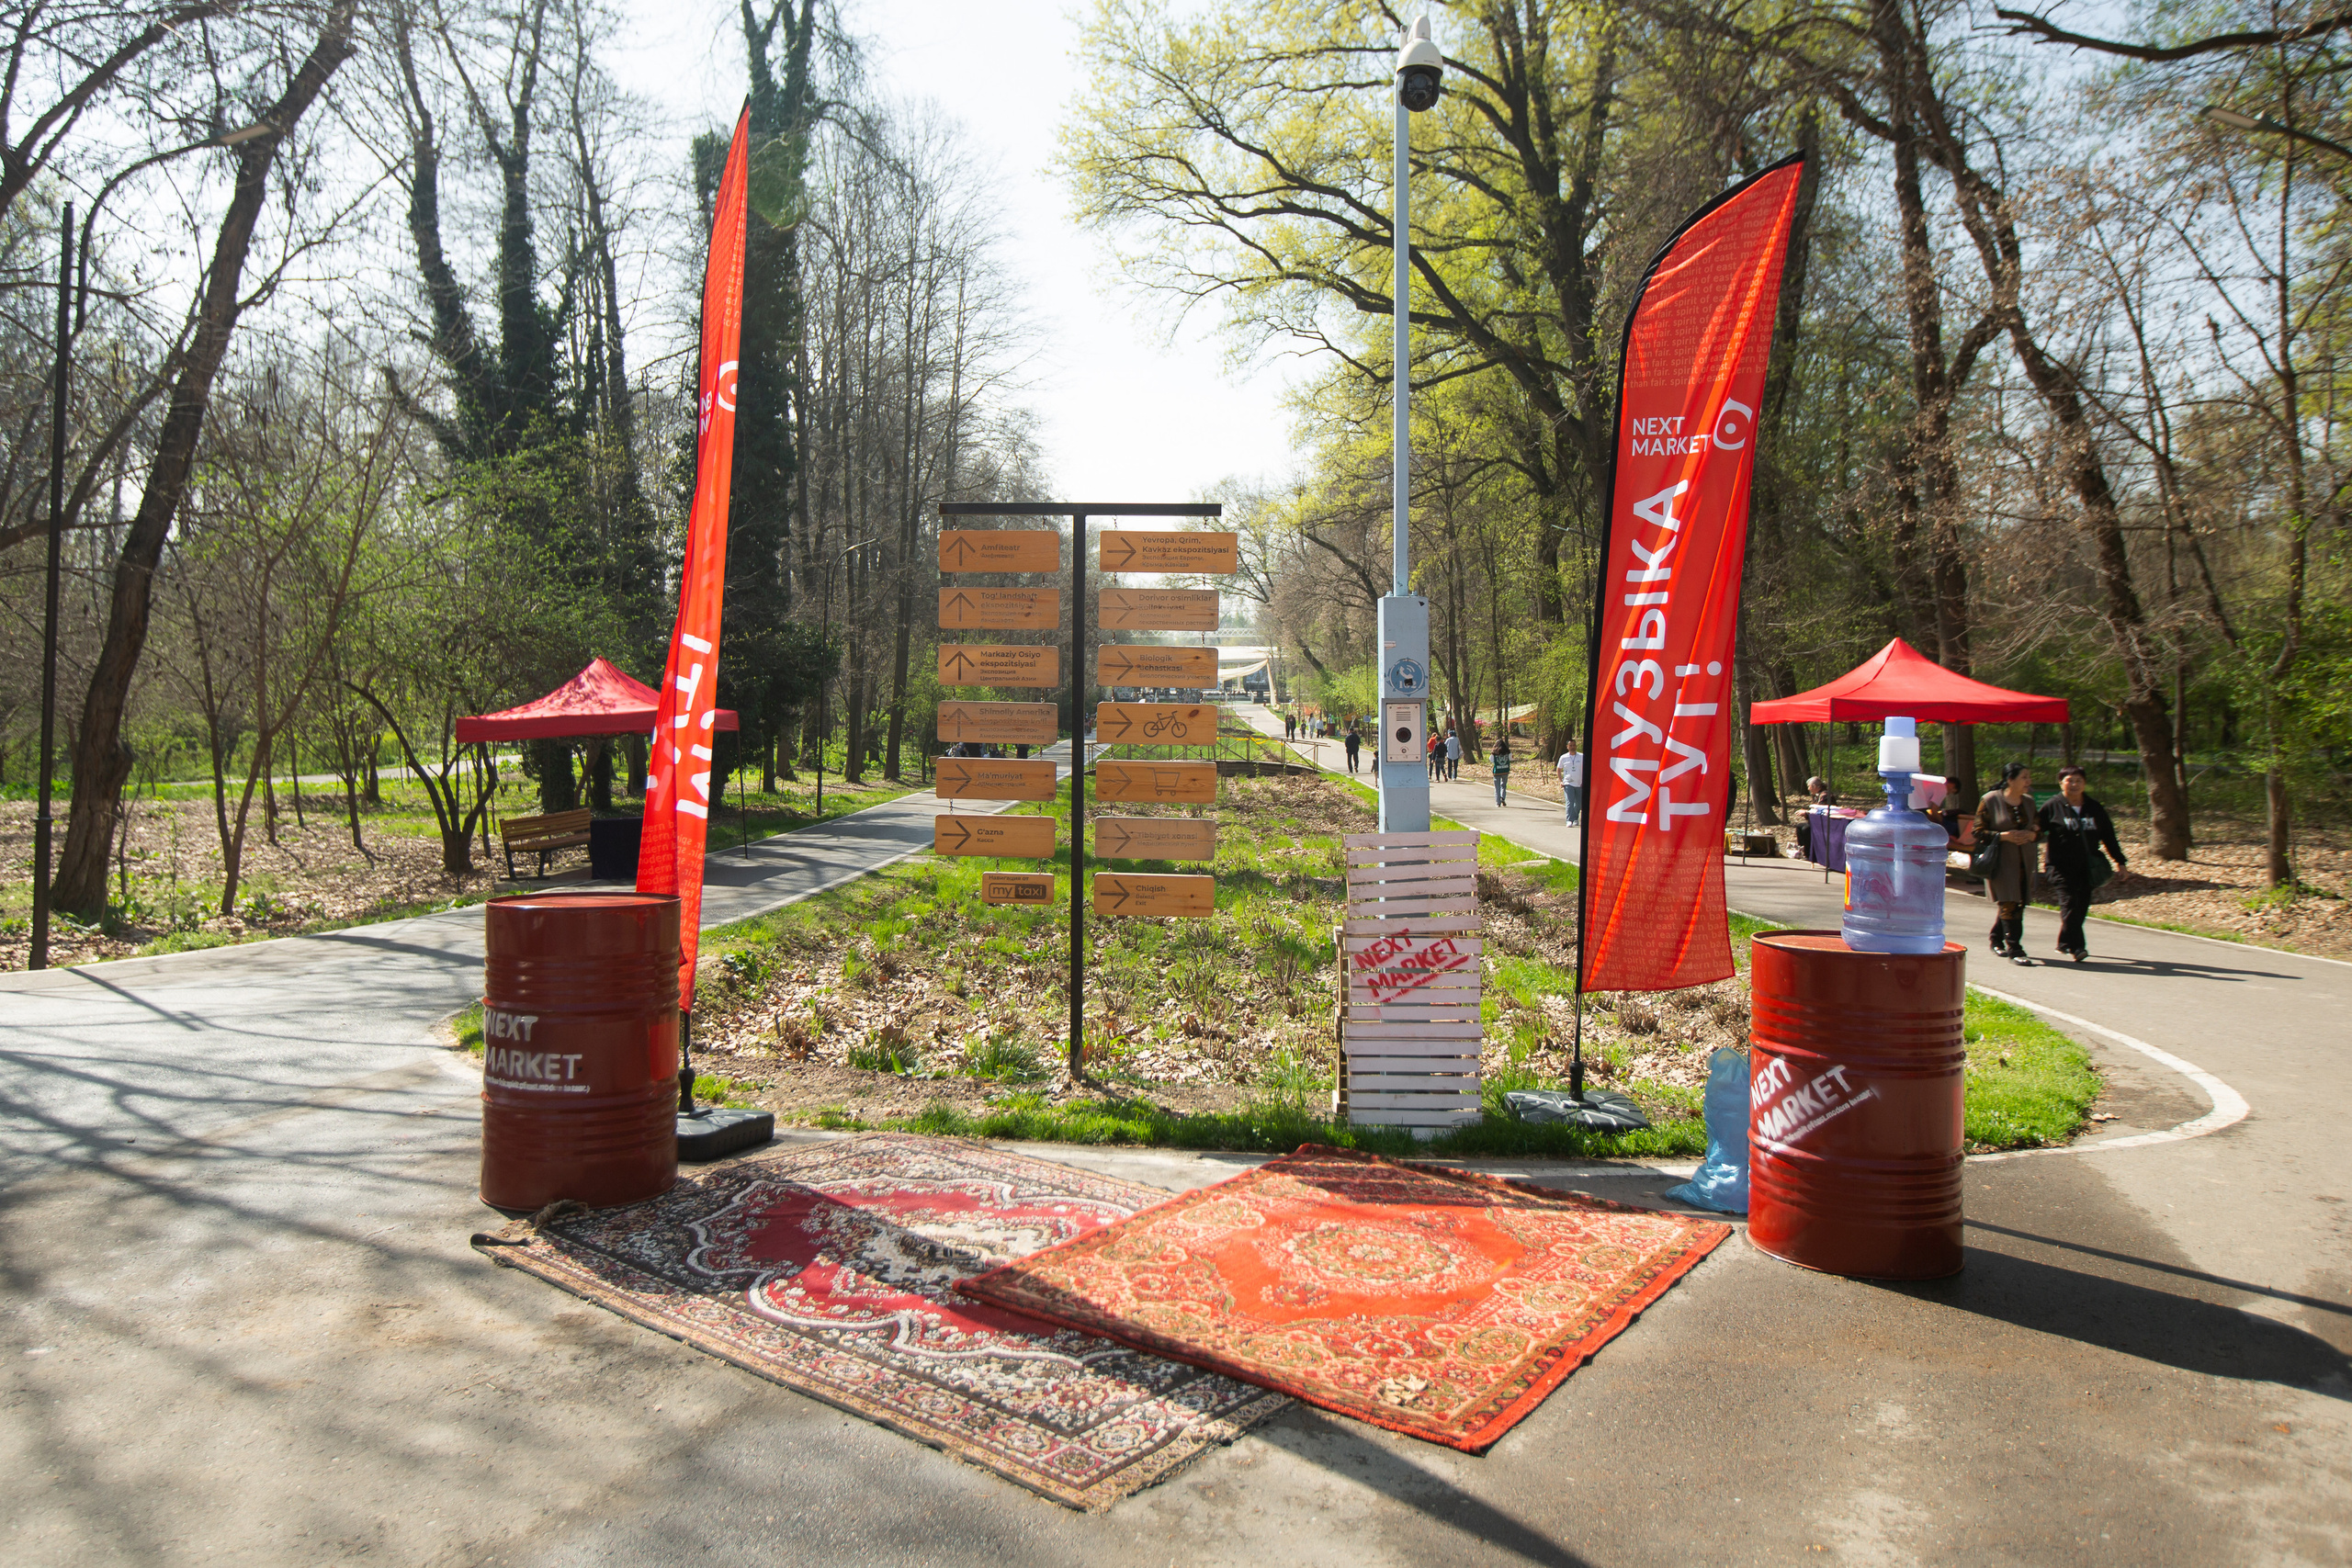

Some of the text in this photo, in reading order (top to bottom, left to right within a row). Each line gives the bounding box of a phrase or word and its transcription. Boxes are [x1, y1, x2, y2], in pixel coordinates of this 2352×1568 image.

[1675, 297, 1697, 307] spirit
[1657, 310, 1672, 318] fair.
[1677, 306, 1699, 316] spirit
[1702, 304, 1712, 312] of
[1655, 319, 1669, 328] fair.
[1674, 315, 1697, 327] spirit
[1700, 313, 1709, 323] of
[1657, 329, 1672, 337] fair.
[1676, 325, 1699, 336] spirit
[1702, 324, 1712, 333] of
[1654, 339, 1668, 347] fair.
[1672, 336, 1695, 347] spirit
[1699, 335, 1709, 344] of
[1656, 348, 1670, 356] fair.
[1675, 346, 1698, 357] spirit
[1652, 358, 1668, 367] fair.
[1671, 356, 1695, 367] spirit
[1654, 367, 1669, 377] fair.
[1674, 365, 1698, 377] spirit
[1651, 378, 1667, 387] fair.
[1670, 376, 1695, 387] spirit
[1633, 416, 1686, 435] NEXT
[1632, 434, 1712, 457] MARKET
[1143, 536, 1176, 545] Yevropa,
[980, 650, 1016, 659] Markaziy
[1606, 479, 1688, 825] МУЗЫКА
[1658, 660, 1722, 831] ТУТ!
[1354, 928, 1413, 969] NEXT
[1367, 935, 1458, 998] MARKET
[485, 1010, 538, 1042] NEXT
[485, 1043, 582, 1080] MARKET
[1750, 1054, 1792, 1111] NEXT
[1757, 1064, 1852, 1143] MARKET
